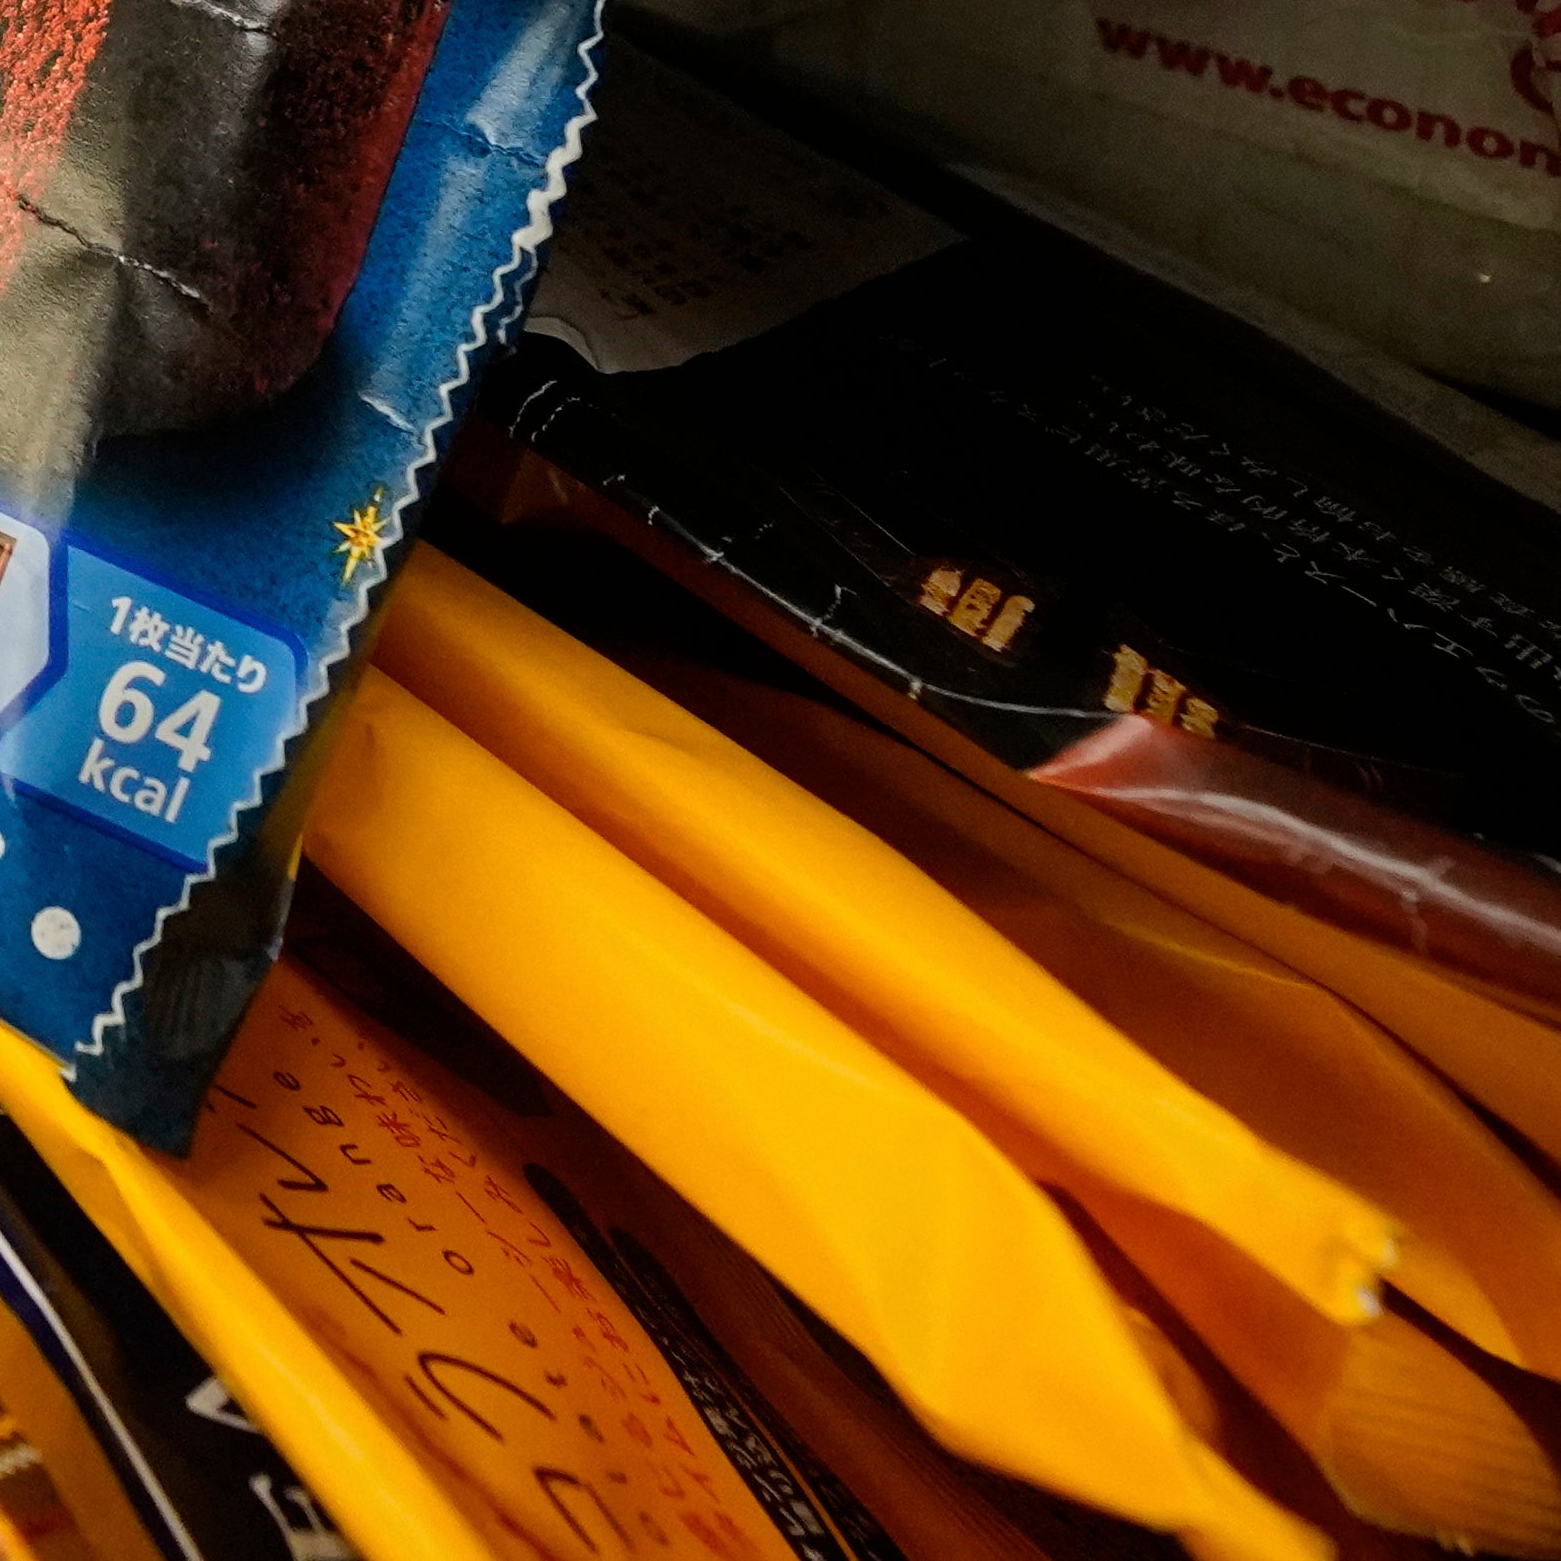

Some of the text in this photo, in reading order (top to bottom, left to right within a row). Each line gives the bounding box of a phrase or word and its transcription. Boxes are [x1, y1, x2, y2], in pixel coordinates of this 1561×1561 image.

[108, 594, 268, 695] 1枚当たり
[96, 660, 225, 775] 64
[77, 739, 191, 825] kcal
[273, 1070, 475, 1276] orange
